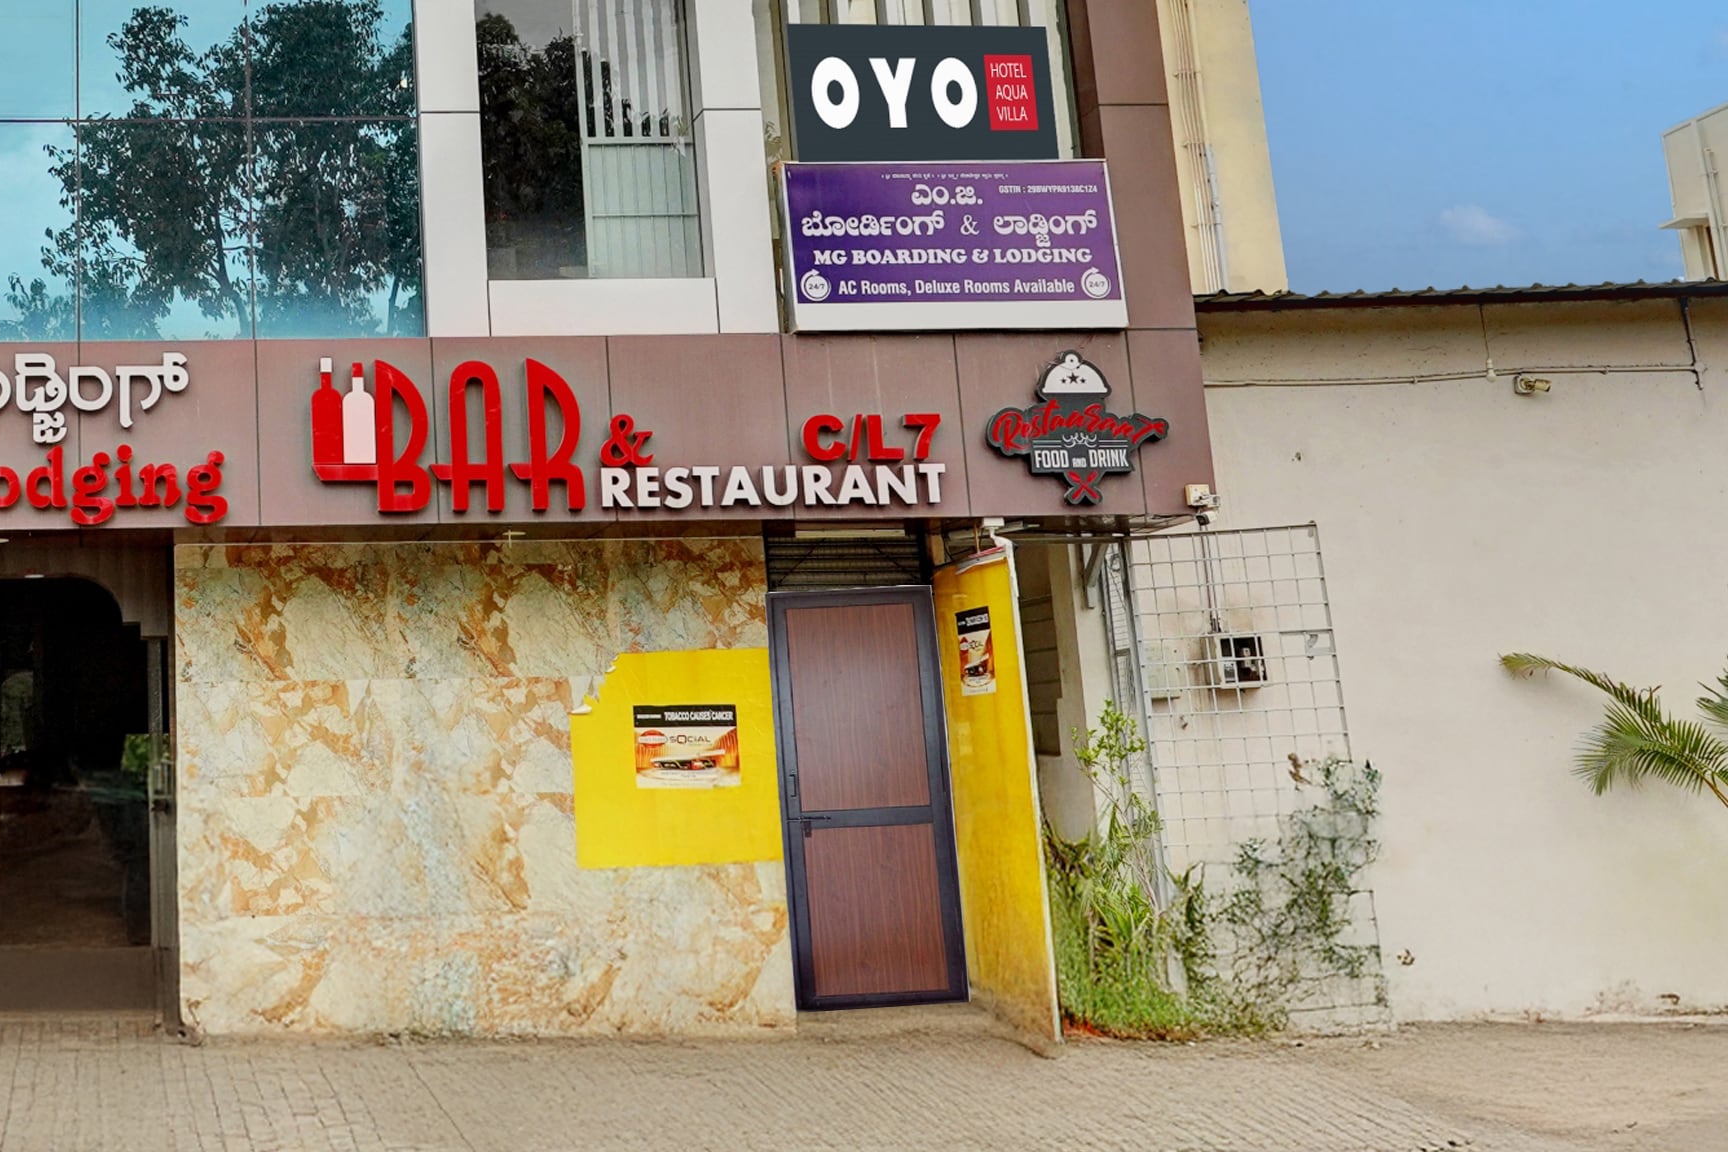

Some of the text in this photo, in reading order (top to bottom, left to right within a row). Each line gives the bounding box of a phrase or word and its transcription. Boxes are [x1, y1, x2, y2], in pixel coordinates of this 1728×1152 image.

[990, 62, 1027, 78] HOTEL
[811, 56, 978, 129] OYO
[995, 84, 1029, 101] AQUA
[996, 106, 1029, 121] VILLA
[960, 215, 980, 236] &
[813, 248, 1093, 266] MG BOARDING & LODGING
[838, 277, 1075, 296] AC Rooms, Deluxe Rooms Available
[313, 357, 586, 512] BAR
[600, 413, 654, 466] &
[1034, 450, 1070, 468] FOOD
[1088, 448, 1129, 467] DRINK
[600, 464, 946, 509] RESTAURANT
[664, 711, 689, 721] TOBACCO
[690, 711, 711, 720] CAUSES
[711, 711, 734, 720] CANCER
